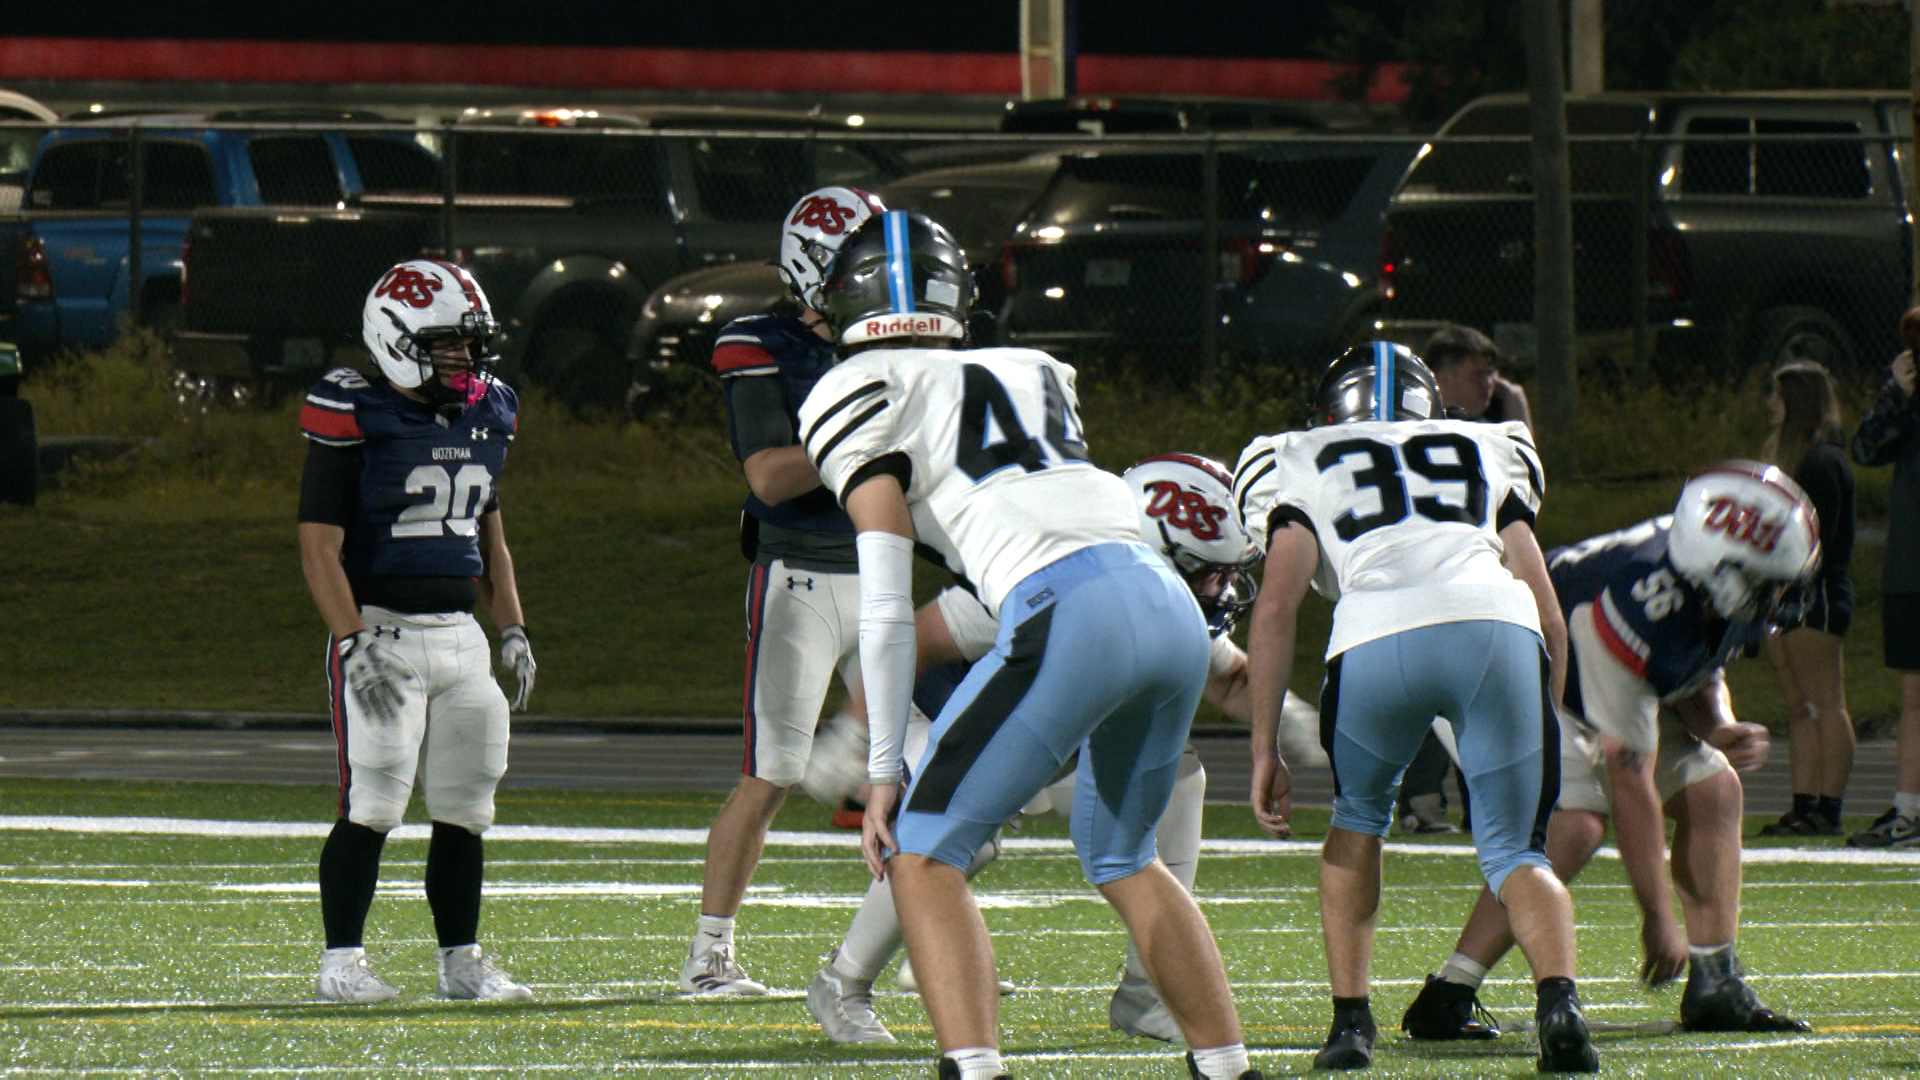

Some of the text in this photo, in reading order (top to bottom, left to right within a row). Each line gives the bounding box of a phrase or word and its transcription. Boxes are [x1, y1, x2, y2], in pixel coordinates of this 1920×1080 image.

[865, 317, 942, 336] Riddell
[431, 446, 472, 460] BOZEMAN
[391, 465, 493, 537] 20
[1315, 433, 1488, 543] 39
[1631, 568, 1684, 622] 56
